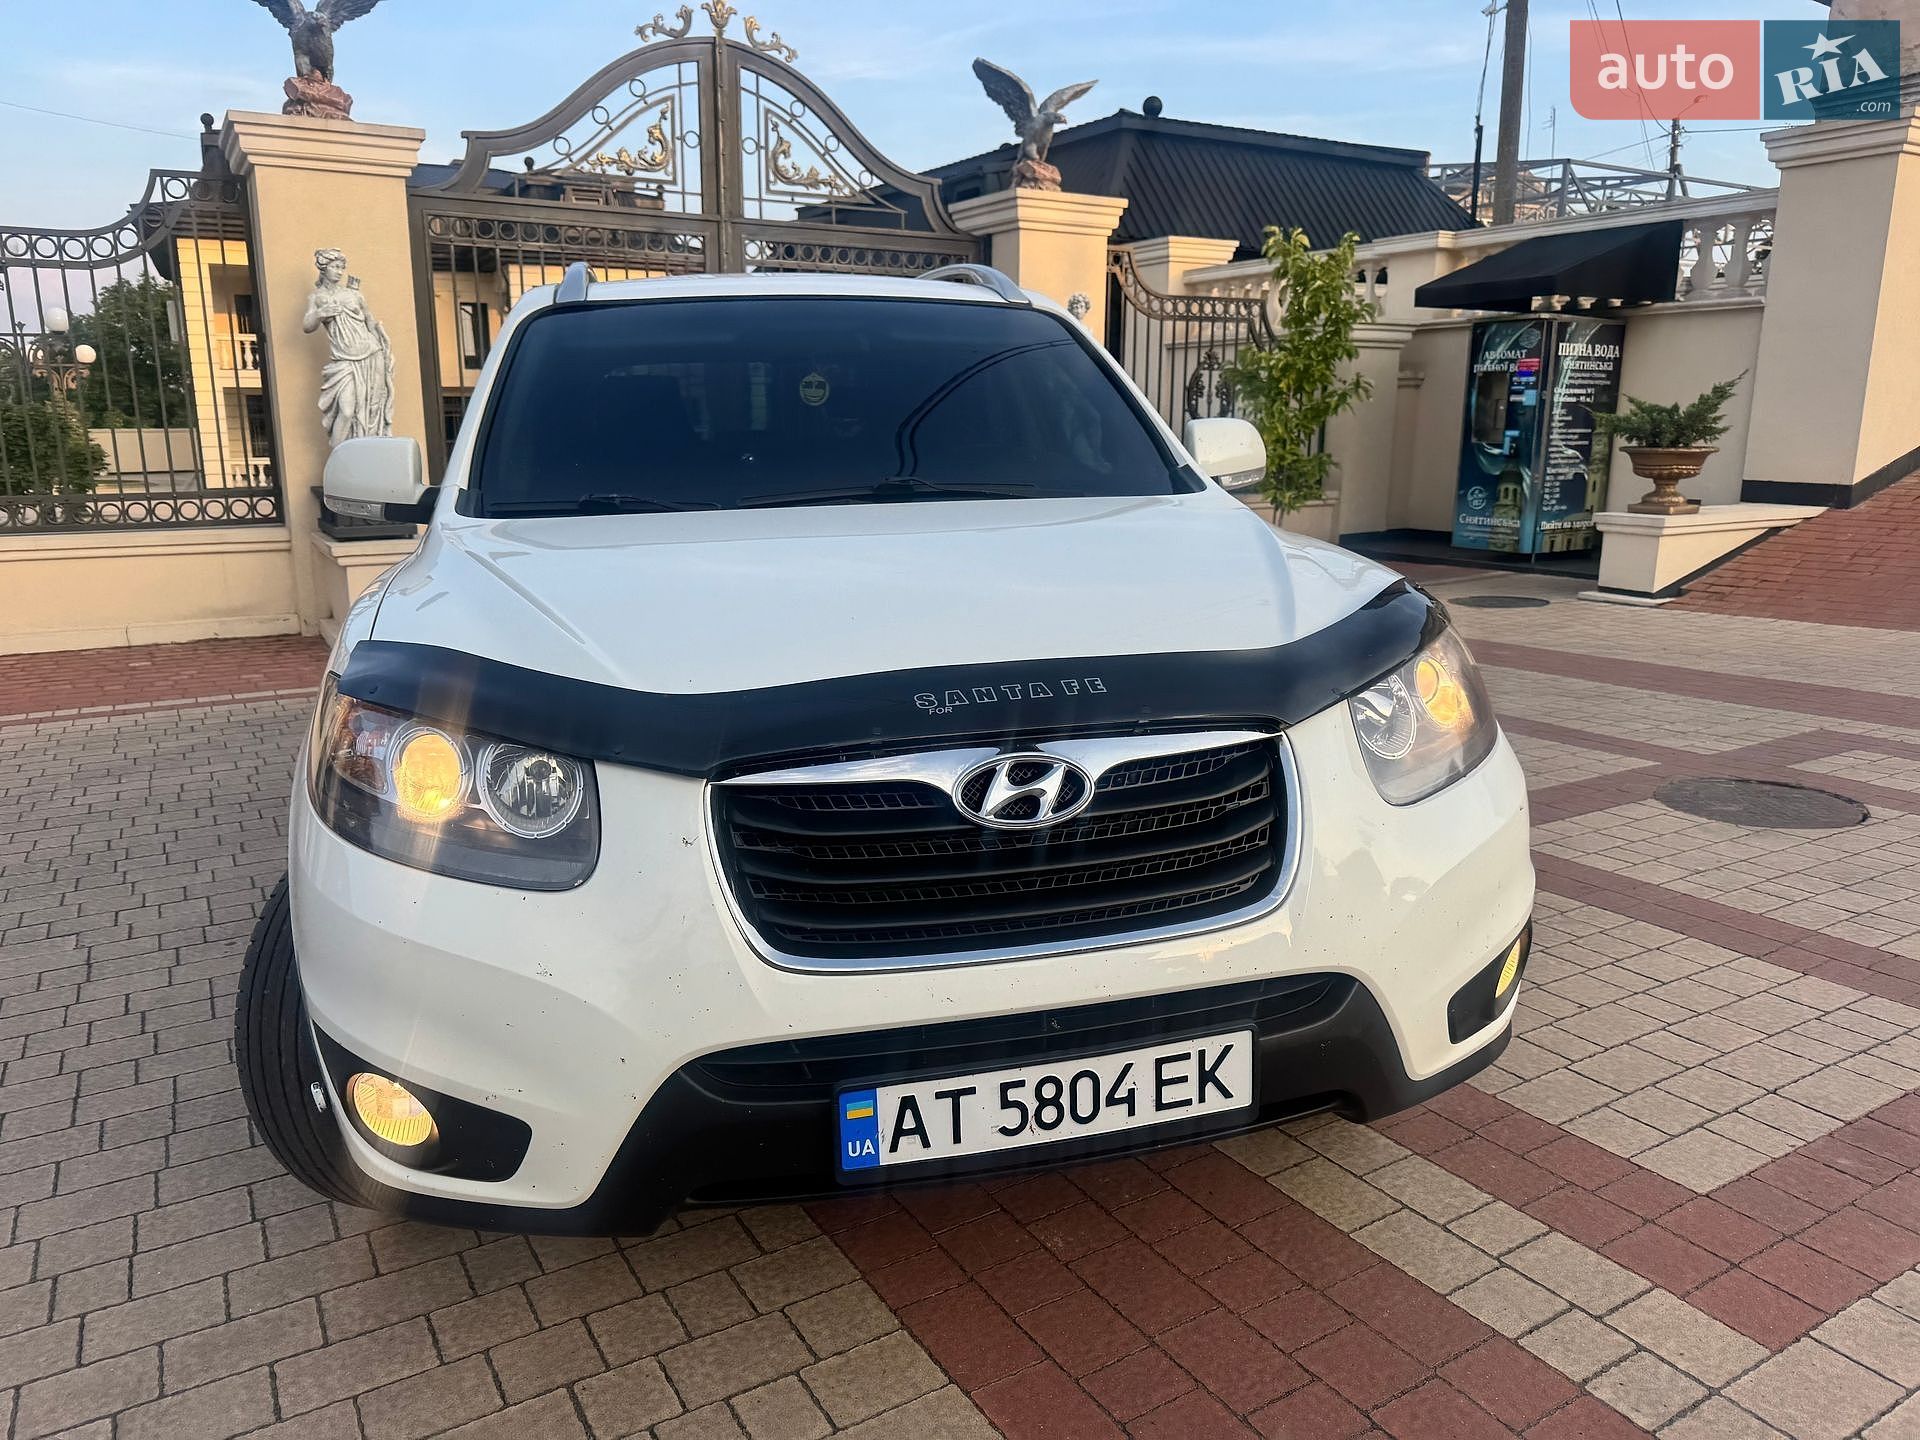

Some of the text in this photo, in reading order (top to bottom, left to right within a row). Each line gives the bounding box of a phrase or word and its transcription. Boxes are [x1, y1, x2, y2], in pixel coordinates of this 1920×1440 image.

[1594, 343, 1620, 360] ВОДА
[914, 677, 1107, 709] SANTA FE
[929, 706, 953, 715] FOR
[888, 1043, 1235, 1153] AT 5804 EK
[848, 1138, 876, 1157] UA
